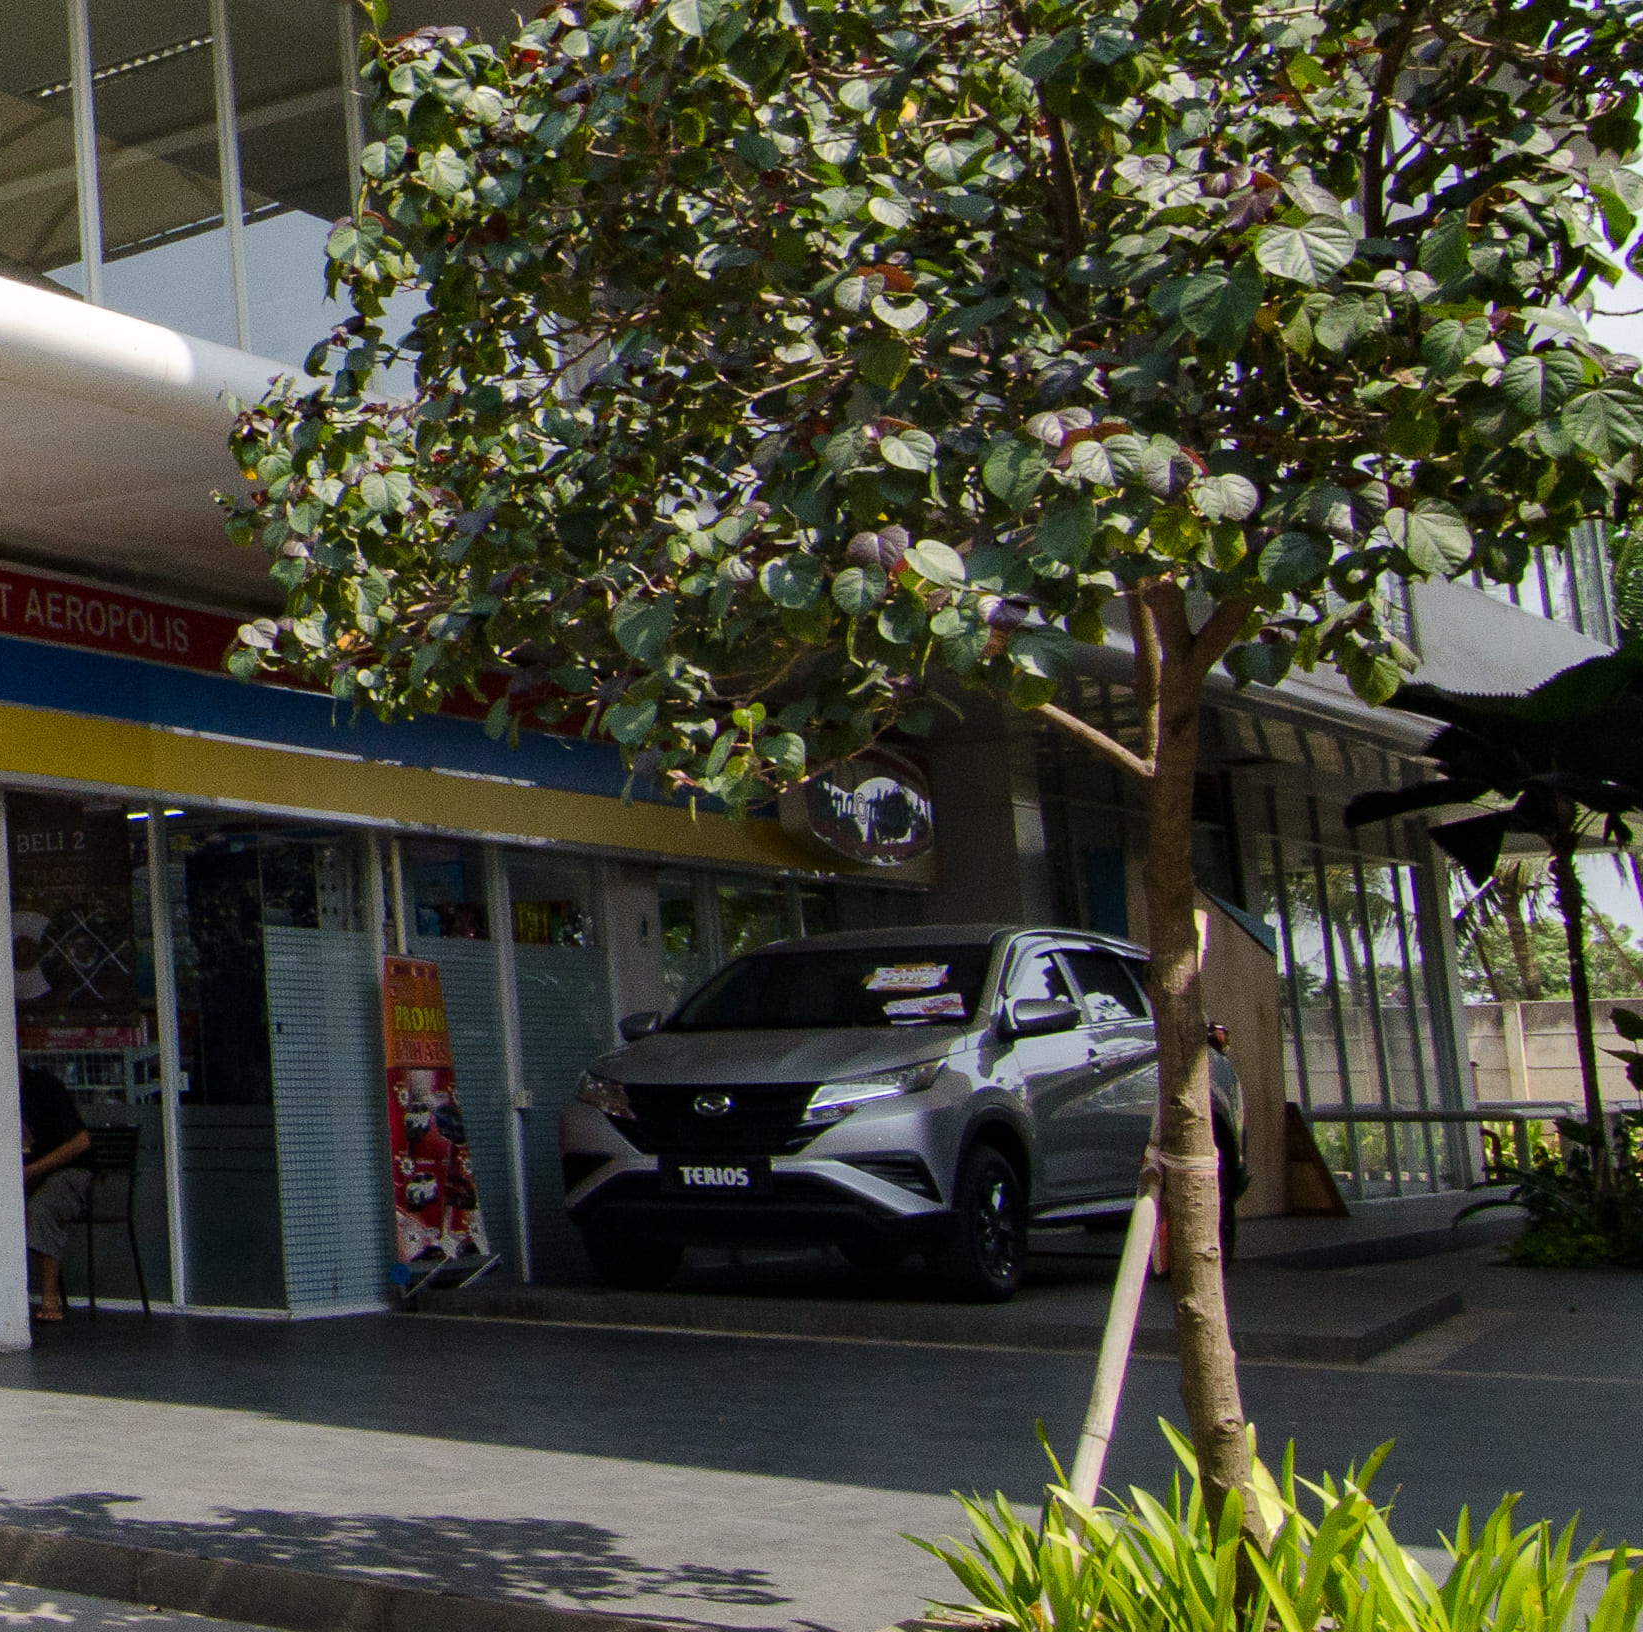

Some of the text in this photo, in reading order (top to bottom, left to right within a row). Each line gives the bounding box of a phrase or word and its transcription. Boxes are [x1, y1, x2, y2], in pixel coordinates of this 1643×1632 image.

[24, 587, 190, 652] AEROPOLIS
[15, 829, 86, 854] BELI 2
[394, 1005, 447, 1033] PROMO
[677, 1165, 751, 1187] TERIOS
